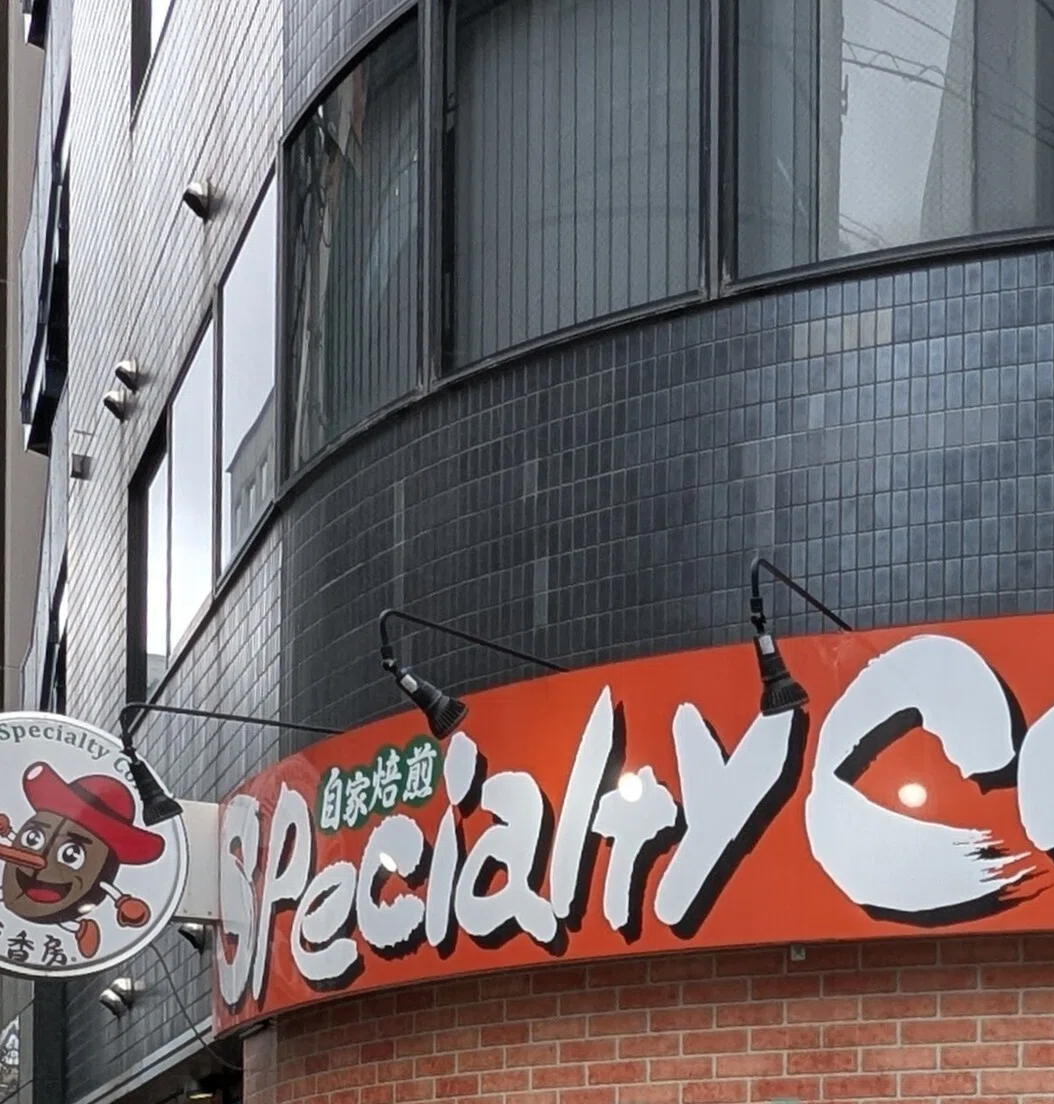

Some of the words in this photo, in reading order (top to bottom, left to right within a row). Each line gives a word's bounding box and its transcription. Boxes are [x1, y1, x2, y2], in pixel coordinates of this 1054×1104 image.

[0, 722, 110, 760] Specialty
[321, 743, 437, 830] 自家焙煎
[0, 924, 69, 967] 香房
